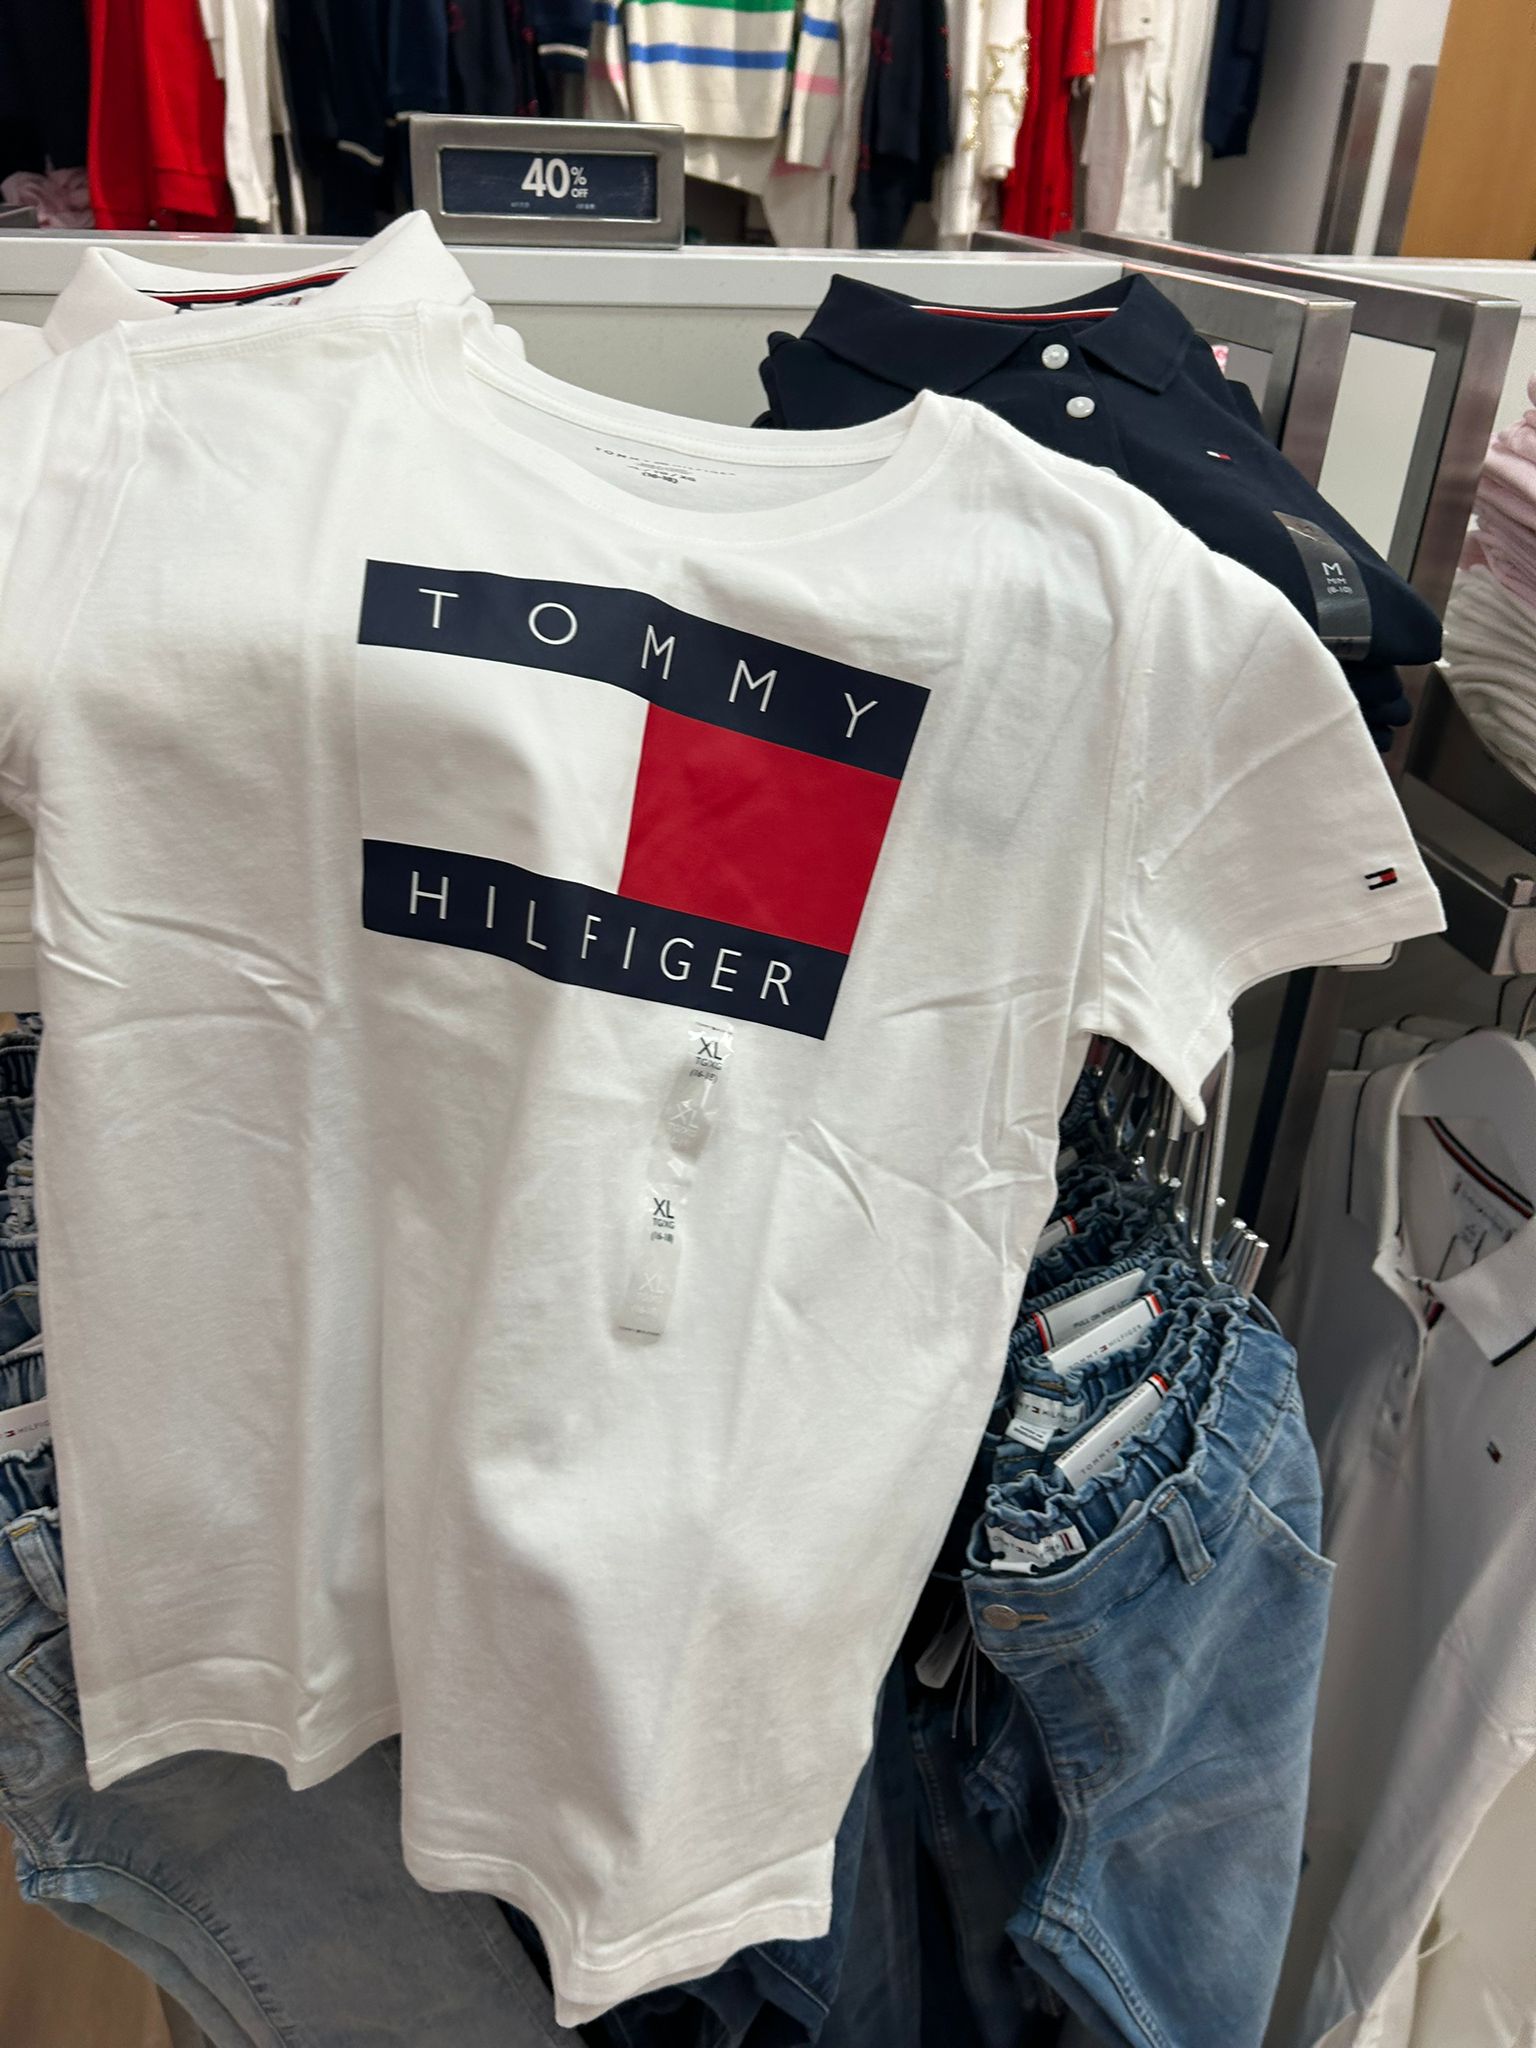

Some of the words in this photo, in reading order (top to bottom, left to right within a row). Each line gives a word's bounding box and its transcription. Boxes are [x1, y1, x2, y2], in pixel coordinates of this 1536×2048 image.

[570, 187, 589, 199] OFF
[1321, 562, 1344, 576] M
[418, 587, 879, 739] TOMMY
[409, 870, 793, 1006] HILFIGER
[697, 1037, 722, 1060] XL
[652, 1197, 675, 1219] XL
[1081, 1447, 1112, 1475] TOMMY
